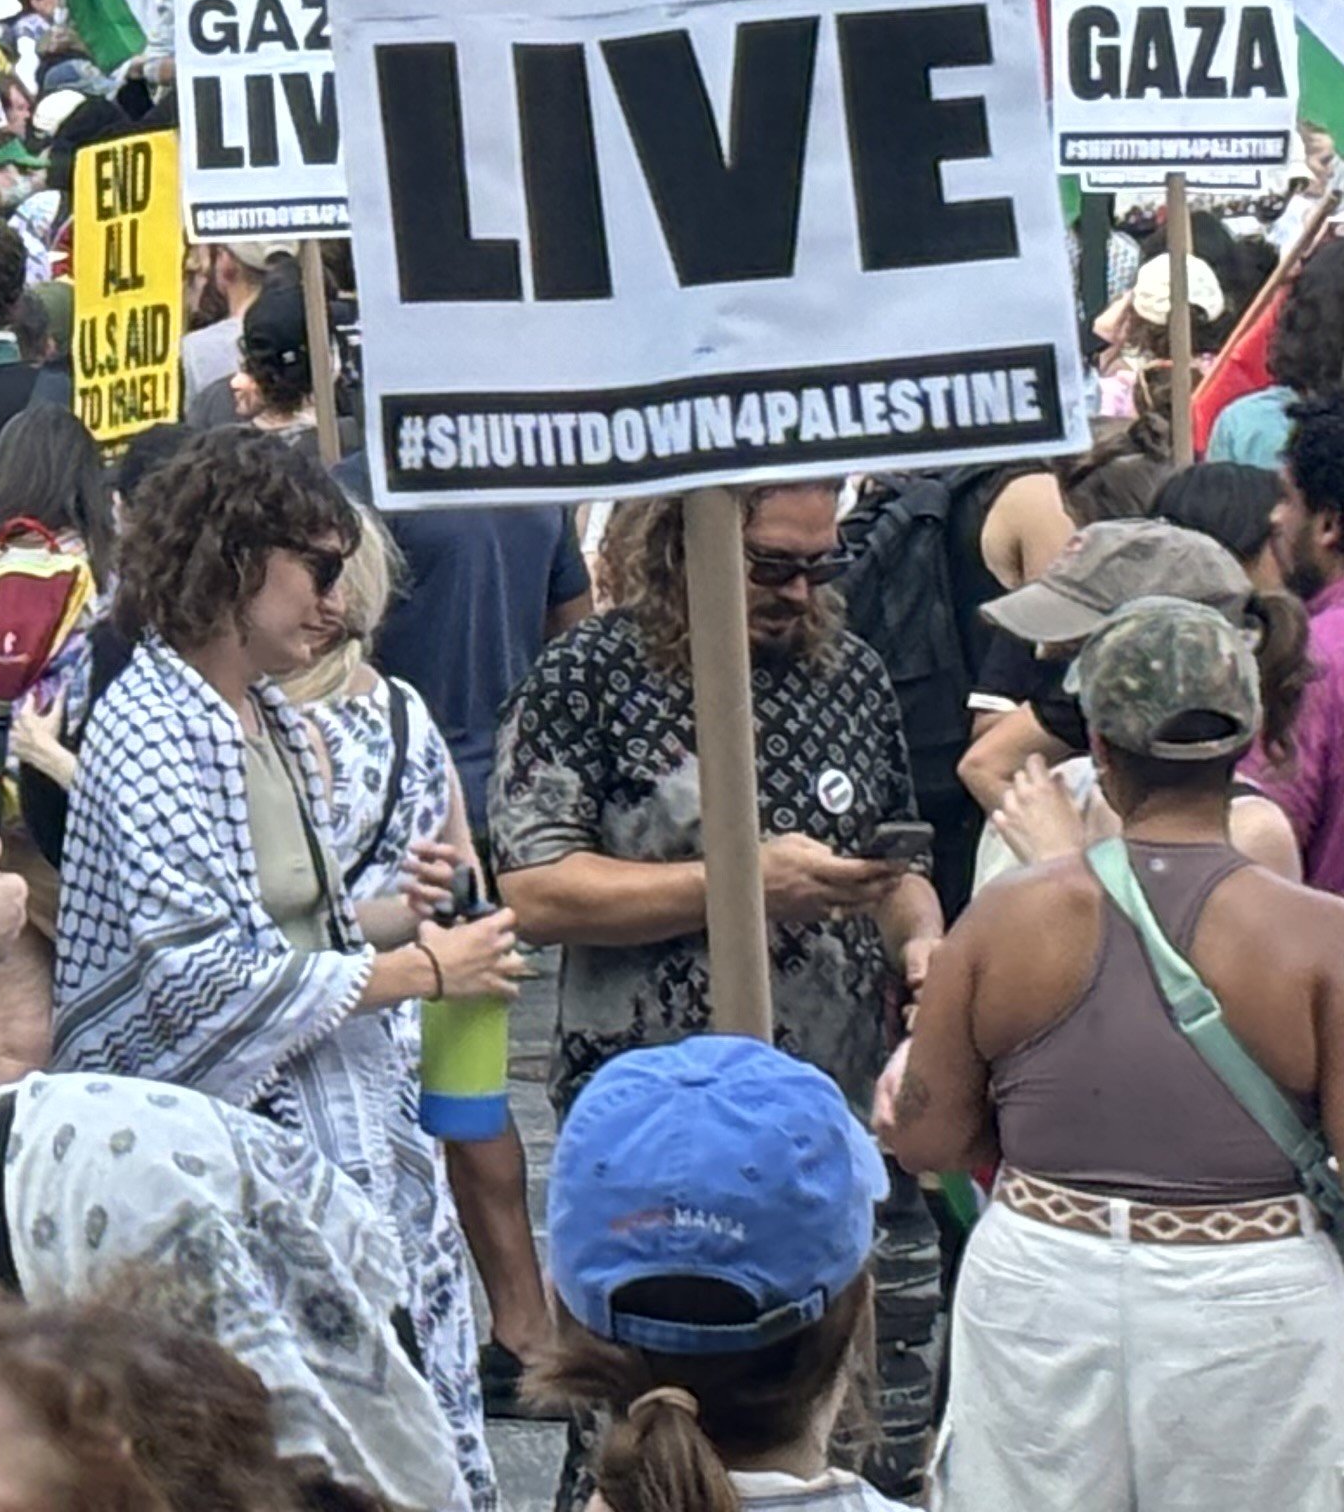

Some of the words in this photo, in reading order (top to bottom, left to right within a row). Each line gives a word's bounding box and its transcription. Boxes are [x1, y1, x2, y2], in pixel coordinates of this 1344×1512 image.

[1067, 4, 1288, 101] GAZA
[192, 71, 340, 170] LIV
[373, 3, 1019, 303] LIVE
[95, 141, 152, 222] END
[102, 218, 145, 298] ALL
[124, 303, 171, 369] AID
[79, 384, 103, 431] TO
[398, 368, 1040, 468] #SHUTITDOWN4PALESTINE
